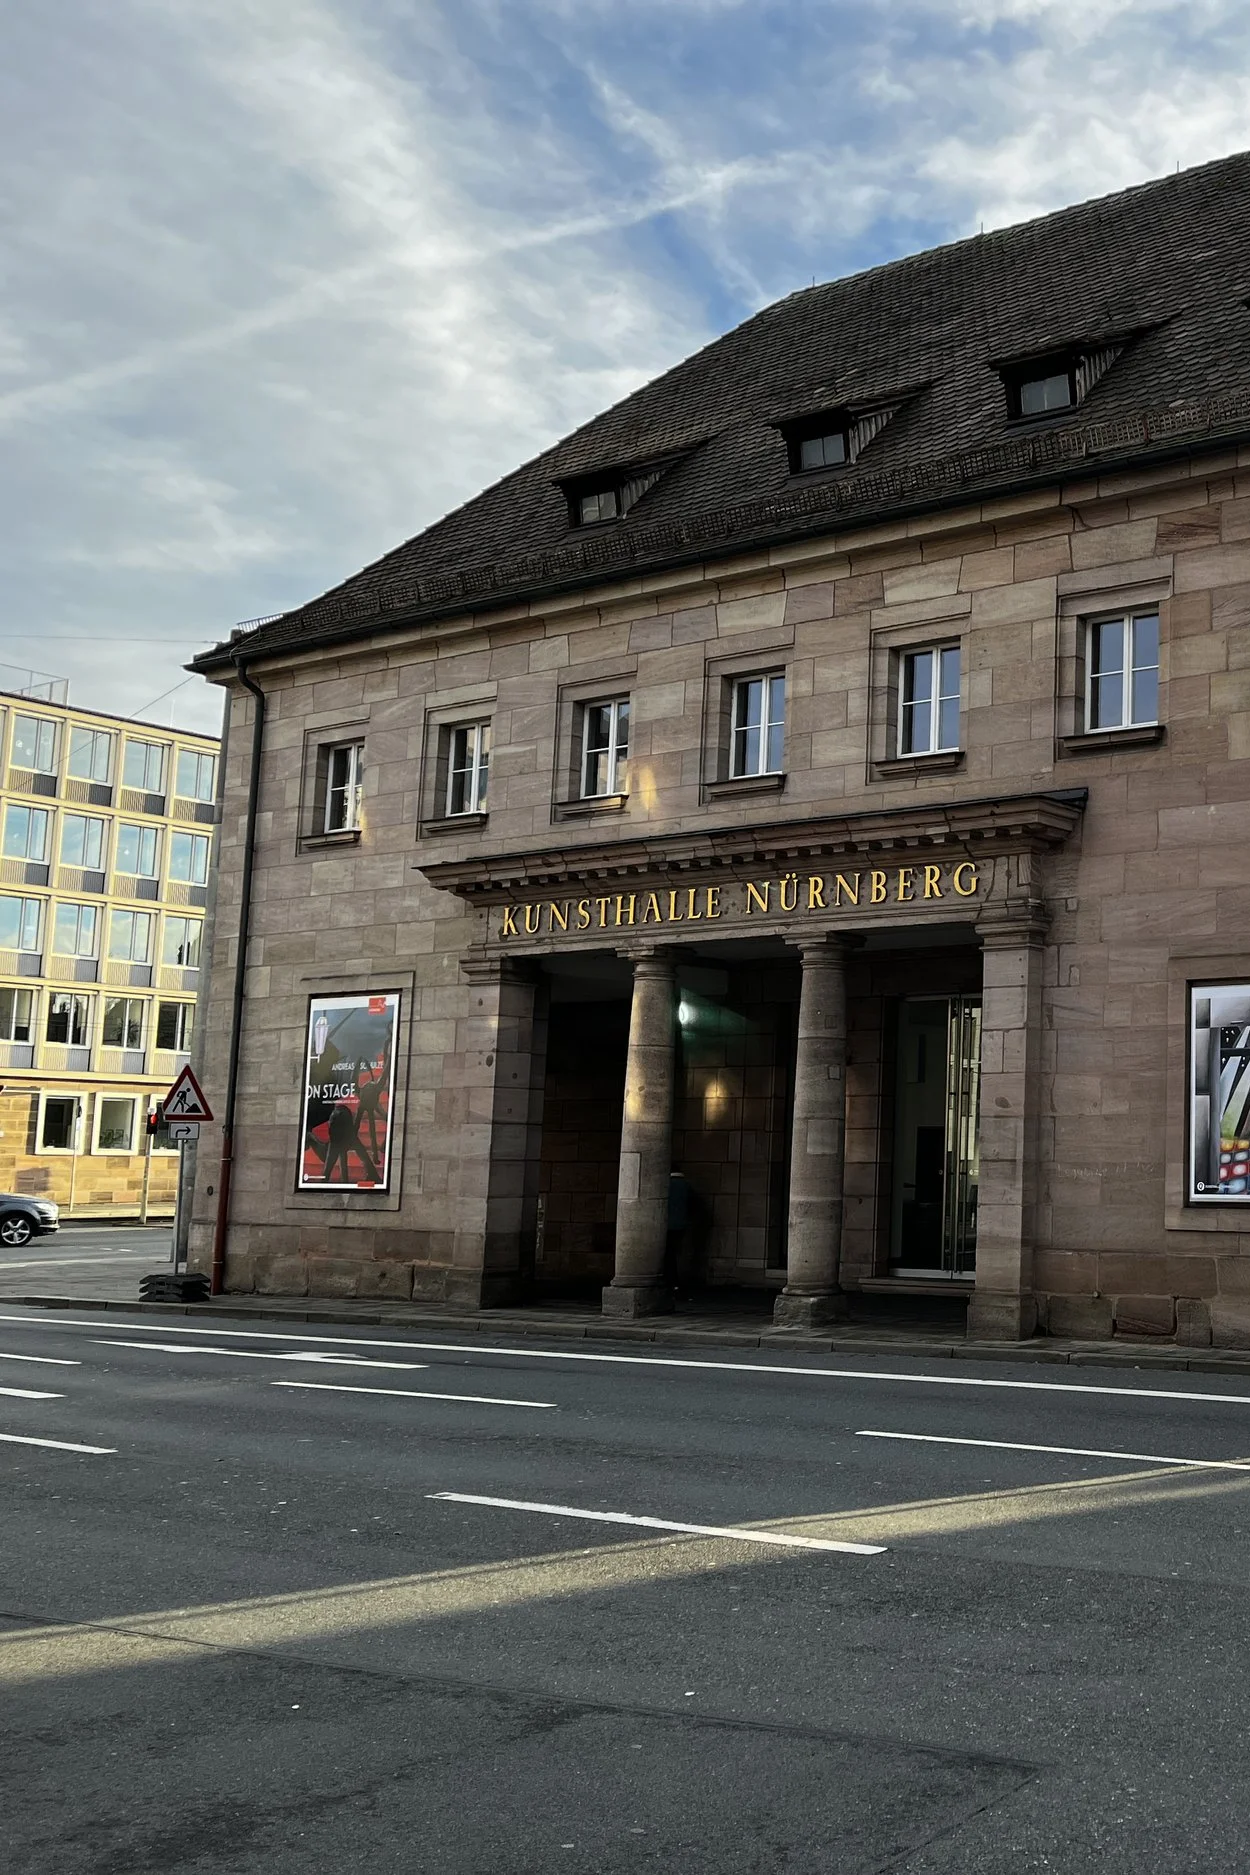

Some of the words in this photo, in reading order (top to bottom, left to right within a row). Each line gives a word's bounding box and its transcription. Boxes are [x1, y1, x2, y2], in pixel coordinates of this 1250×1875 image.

[501, 885, 722, 937] KUNSTHALLE
[745, 862, 981, 915] NÜRNBERG
[331, 1062, 355, 1071] ANDREAS
[360, 1060, 384, 1070] SCULZE
[322, 1083, 356, 1099] STAGE
